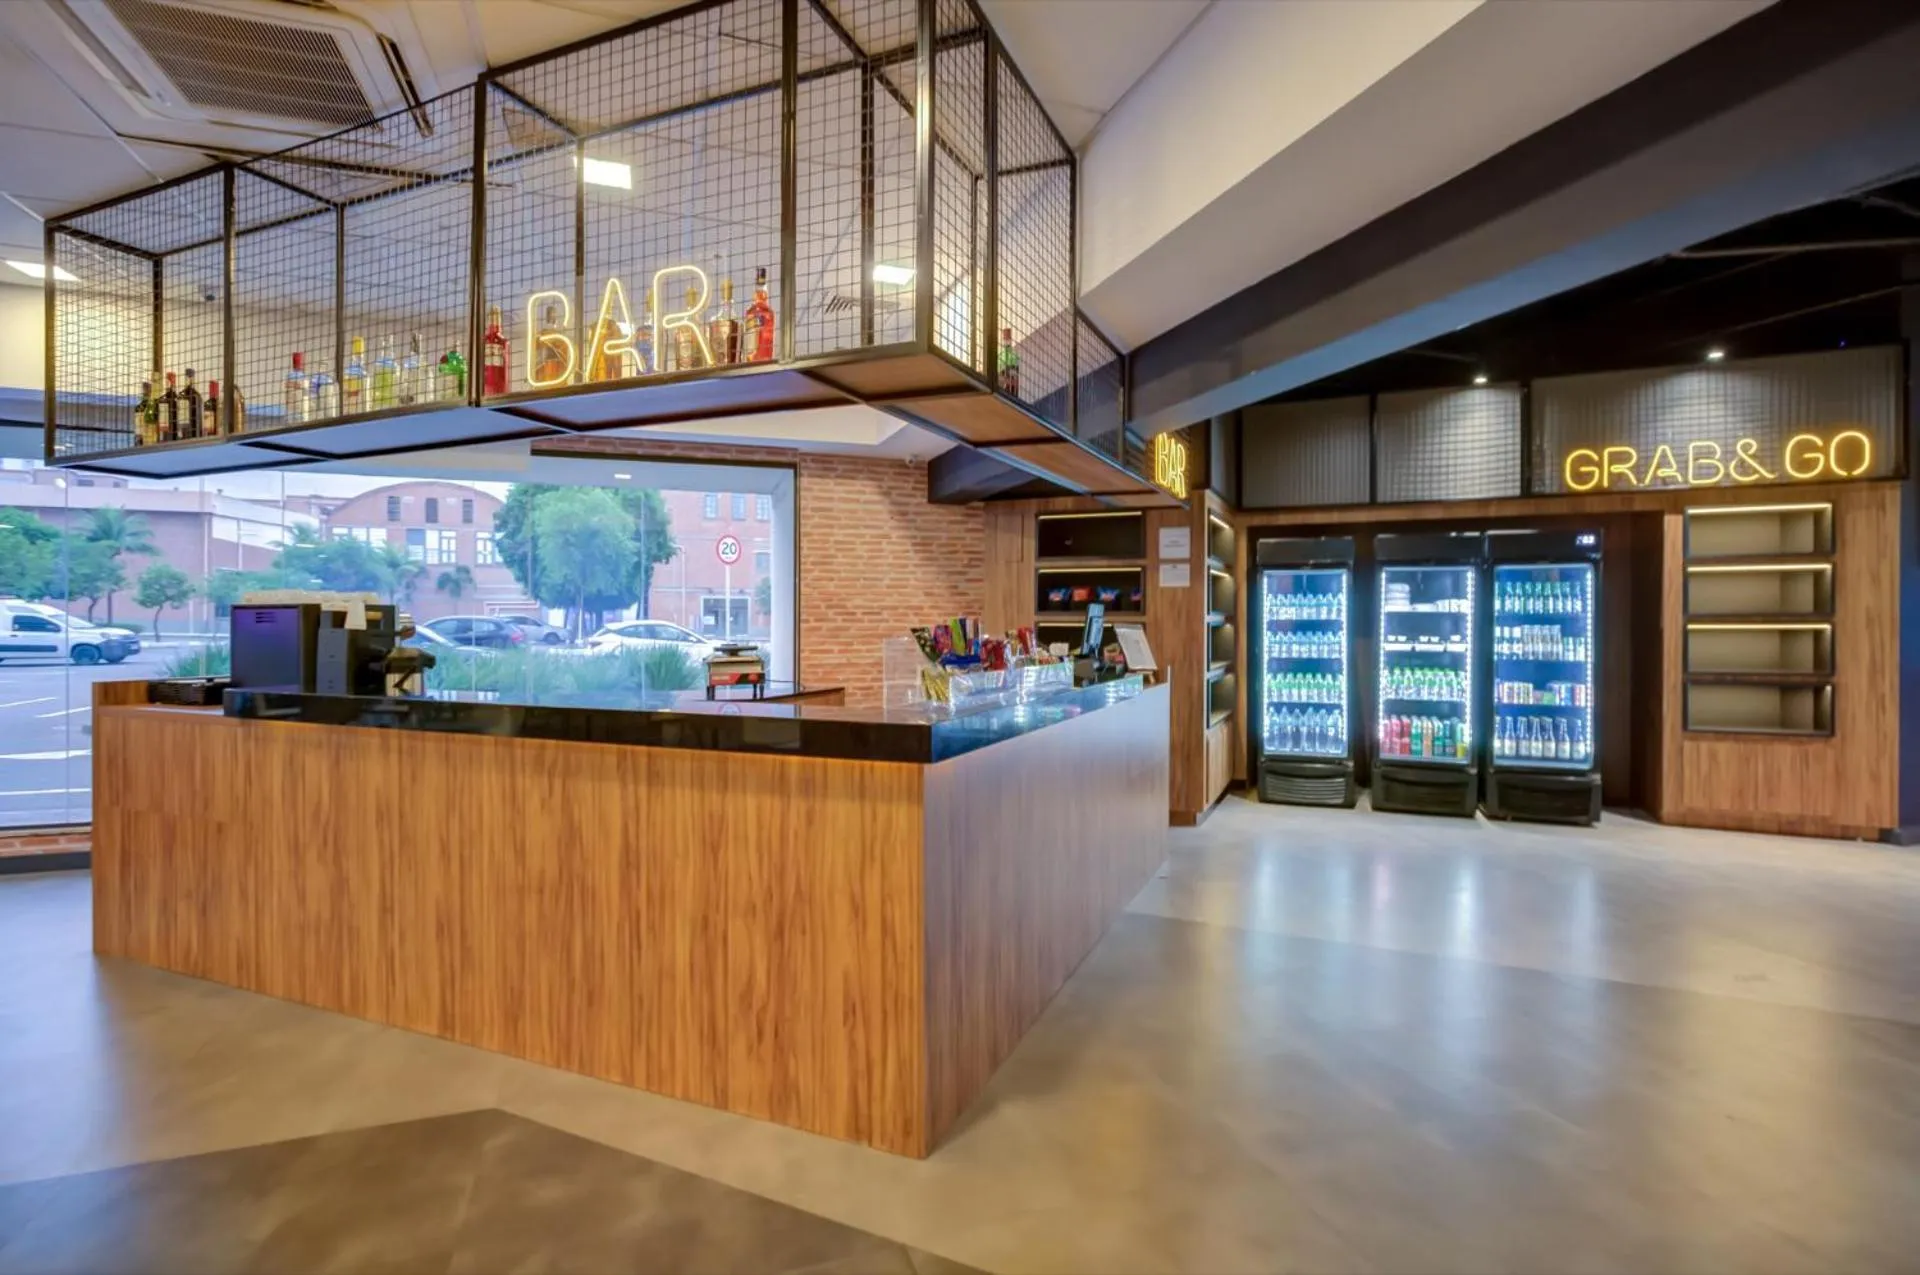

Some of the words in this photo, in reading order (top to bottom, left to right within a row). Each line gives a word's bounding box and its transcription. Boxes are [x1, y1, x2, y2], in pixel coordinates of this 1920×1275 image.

[527, 265, 715, 387] BAR
[1155, 432, 1187, 499] BAR
[1784, 430, 1872, 479] GO
[721, 542, 737, 555] 20
